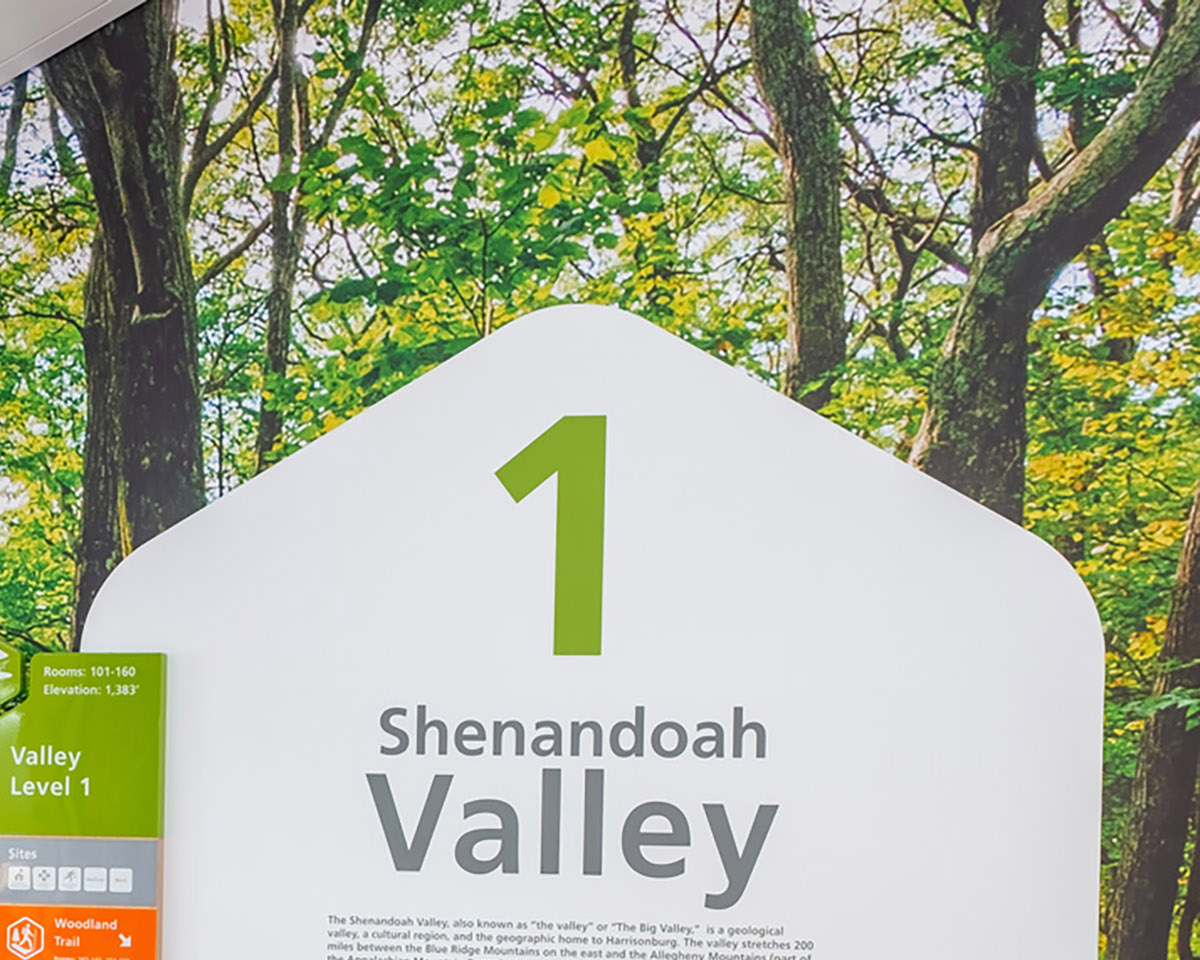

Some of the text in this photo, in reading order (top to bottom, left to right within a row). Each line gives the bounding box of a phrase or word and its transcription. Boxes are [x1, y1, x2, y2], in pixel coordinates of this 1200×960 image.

[494, 415, 607, 656] 1
[43, 666, 136, 677] Rooms: 101-160
[43, 684, 101, 695] Elevation:
[379, 704, 767, 759] Shenandoah
[10, 745, 81, 771] Valley
[11, 776, 90, 796] Level 1
[365, 768, 780, 910] Valley
[8, 848, 38, 860] Sites
[54, 918, 118, 930] Woodland
[327, 915, 347, 925] The
[348, 915, 414, 927] Shenandoah
[452, 918, 474, 928] also
[476, 918, 513, 929] known
[639, 922, 657, 935] Big
[726, 925, 784, 937] geological
[54, 936, 80, 947] Trail
[370, 929, 411, 939] cultural
[452, 931, 473, 941] and
[475, 931, 493, 941] the
[495, 933, 555, 945] geographic
[557, 933, 589, 944] home
[682, 936, 703, 947] The
[705, 937, 739, 950] valley
[741, 939, 791, 949] stretches
[326, 941, 354, 951] miles
[356, 941, 402, 952] between
[404, 943, 422, 953] the
[483, 944, 540, 956] Mountains
[559, 946, 577, 957] the
[579, 948, 603, 957] east
[604, 948, 626, 958] and
[628, 948, 647, 958] the
[707, 950, 767, 960] Mountains
